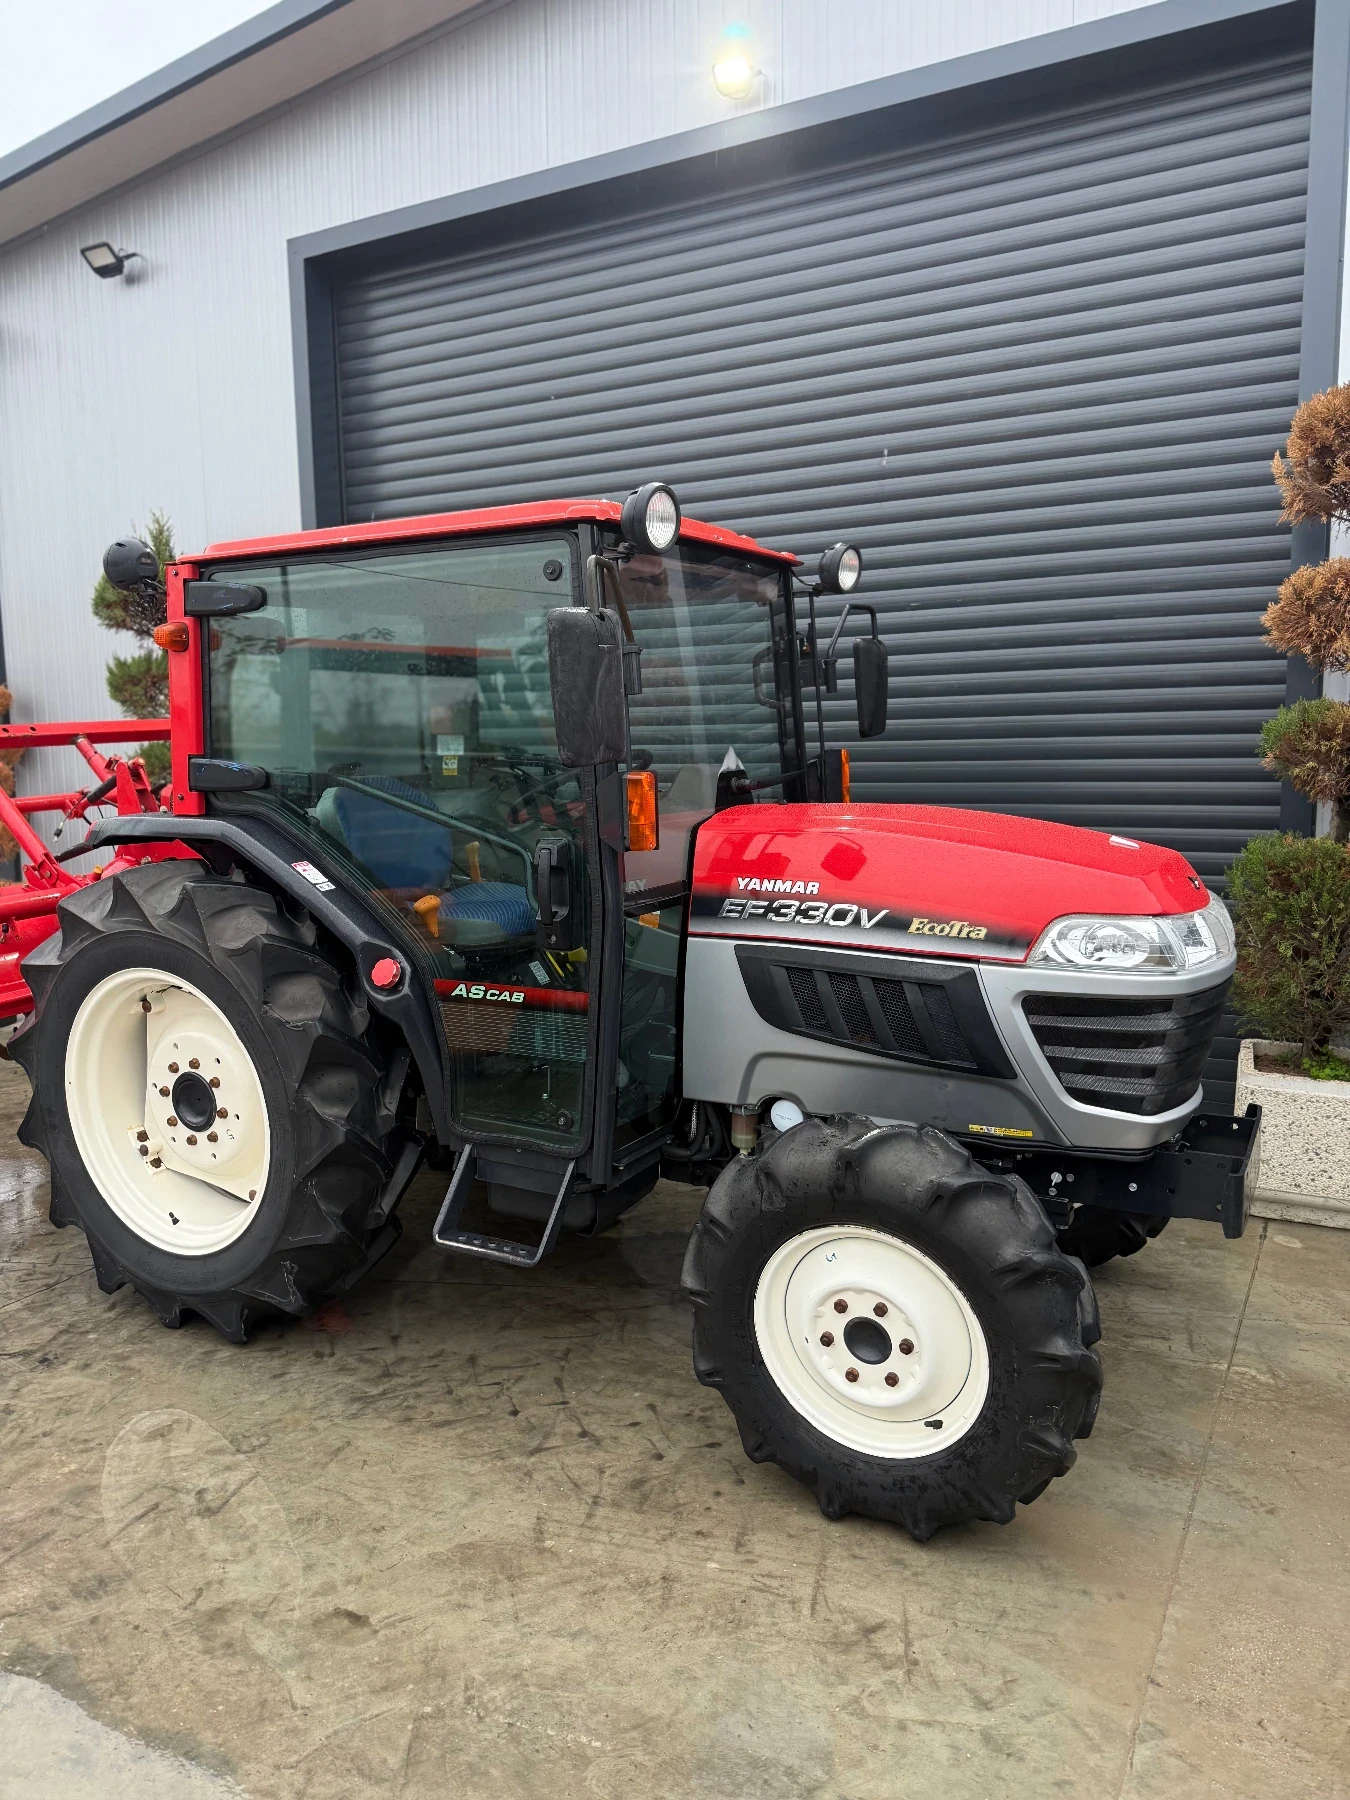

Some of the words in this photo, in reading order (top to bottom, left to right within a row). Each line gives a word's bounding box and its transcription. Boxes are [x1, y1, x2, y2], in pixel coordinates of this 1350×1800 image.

[736, 876, 821, 896] YANMAR
[717, 898, 891, 930] EF330V
[907, 917, 988, 940] EcoTra
